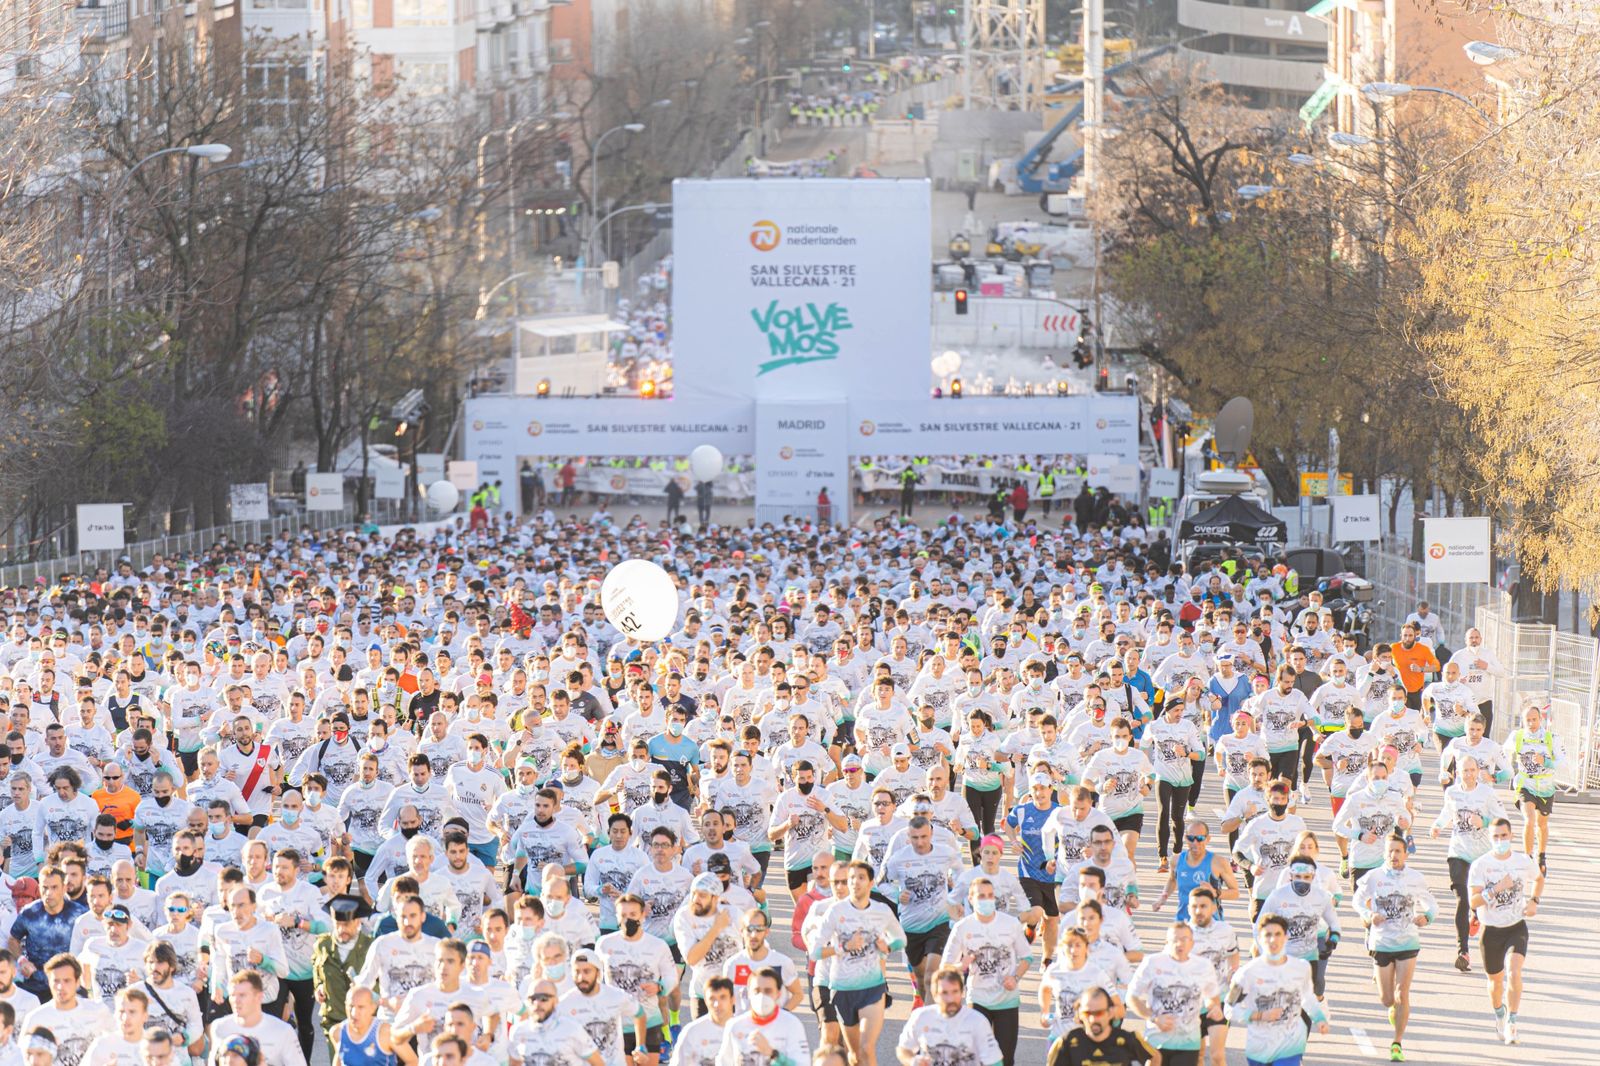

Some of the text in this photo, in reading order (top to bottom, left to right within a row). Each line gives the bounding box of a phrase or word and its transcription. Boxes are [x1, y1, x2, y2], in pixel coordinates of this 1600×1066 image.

[1287, 15, 1303, 35] A
[786, 223, 839, 234] nationale
[786, 235, 857, 246] nederlanden
[750, 264, 856, 276] SAN SILVESTRE
[750, 276, 830, 287] VALLECANA
[841, 276, 855, 287] 21
[750, 299, 854, 333] VOLVE
[767, 328, 841, 356] MOS
[587, 423, 609, 433] SAN
[611, 423, 667, 434] SILVESTRE
[669, 423, 730, 434] VALLECANA
[736, 424, 749, 434] 21
[777, 419, 826, 430] MADRID
[919, 423, 941, 432] SAN
[943, 422, 999, 432] SILVESTRE
[1002, 421, 1062, 431] VALLECANA
[1069, 421, 1081, 431] 21
[465, 791, 476, 799] Fly
